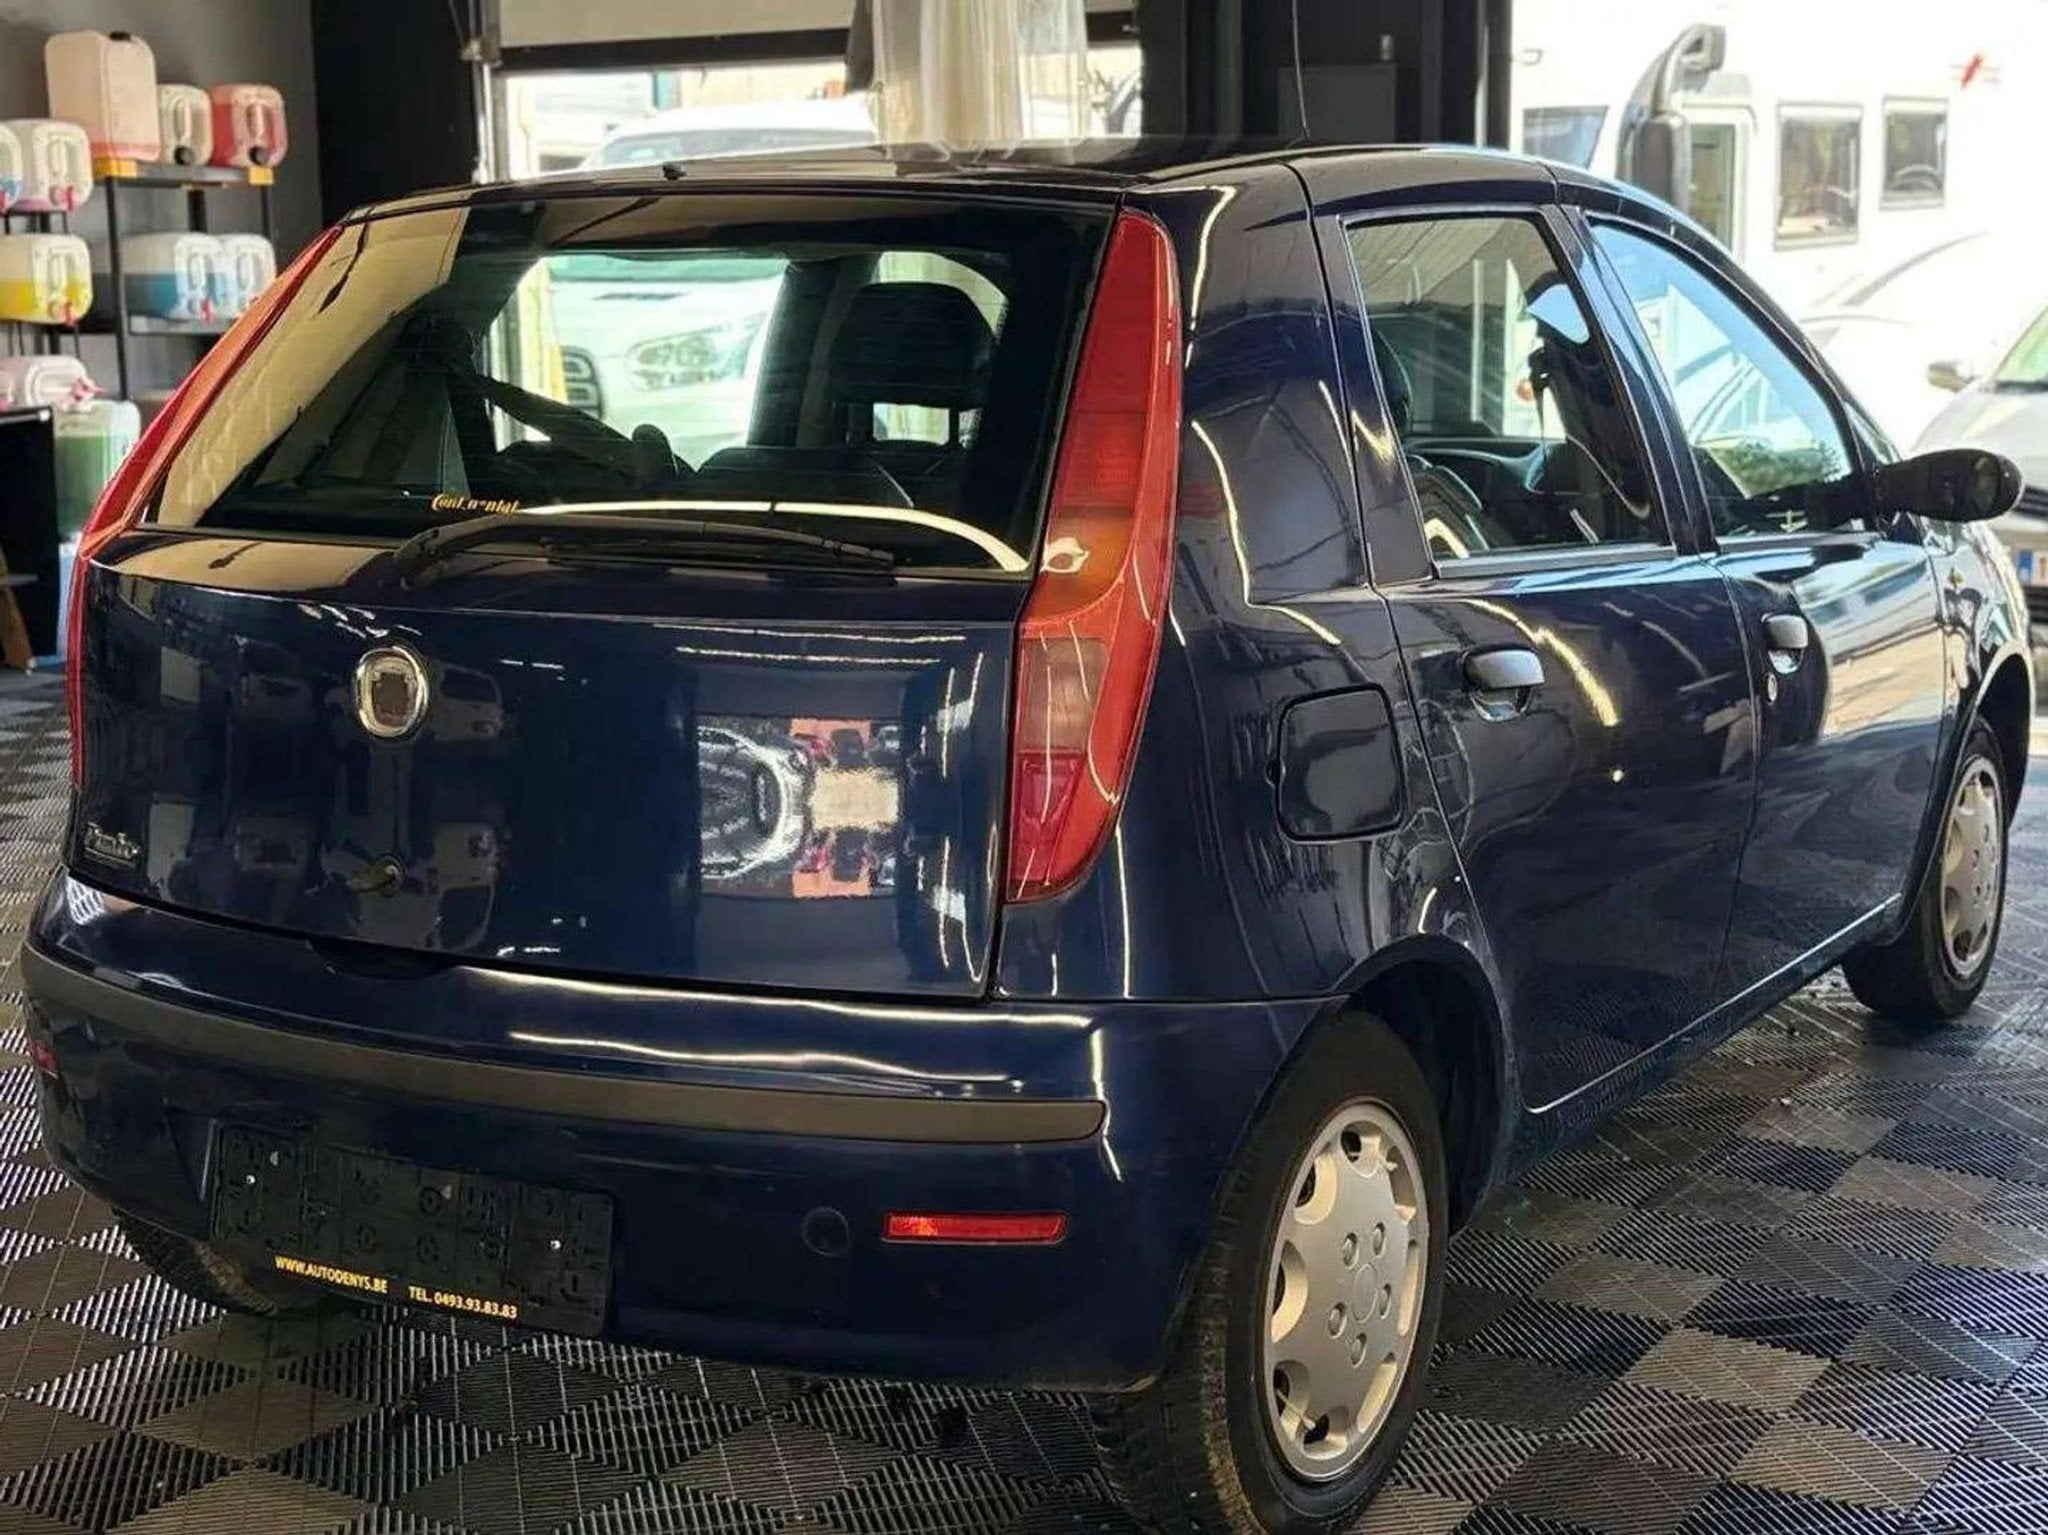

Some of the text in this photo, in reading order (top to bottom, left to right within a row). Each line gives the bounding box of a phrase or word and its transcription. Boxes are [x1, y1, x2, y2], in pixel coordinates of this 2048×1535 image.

[275, 1255, 518, 1319] WWW.AUTODENYS.BE TEL. 0493.93.83.83
